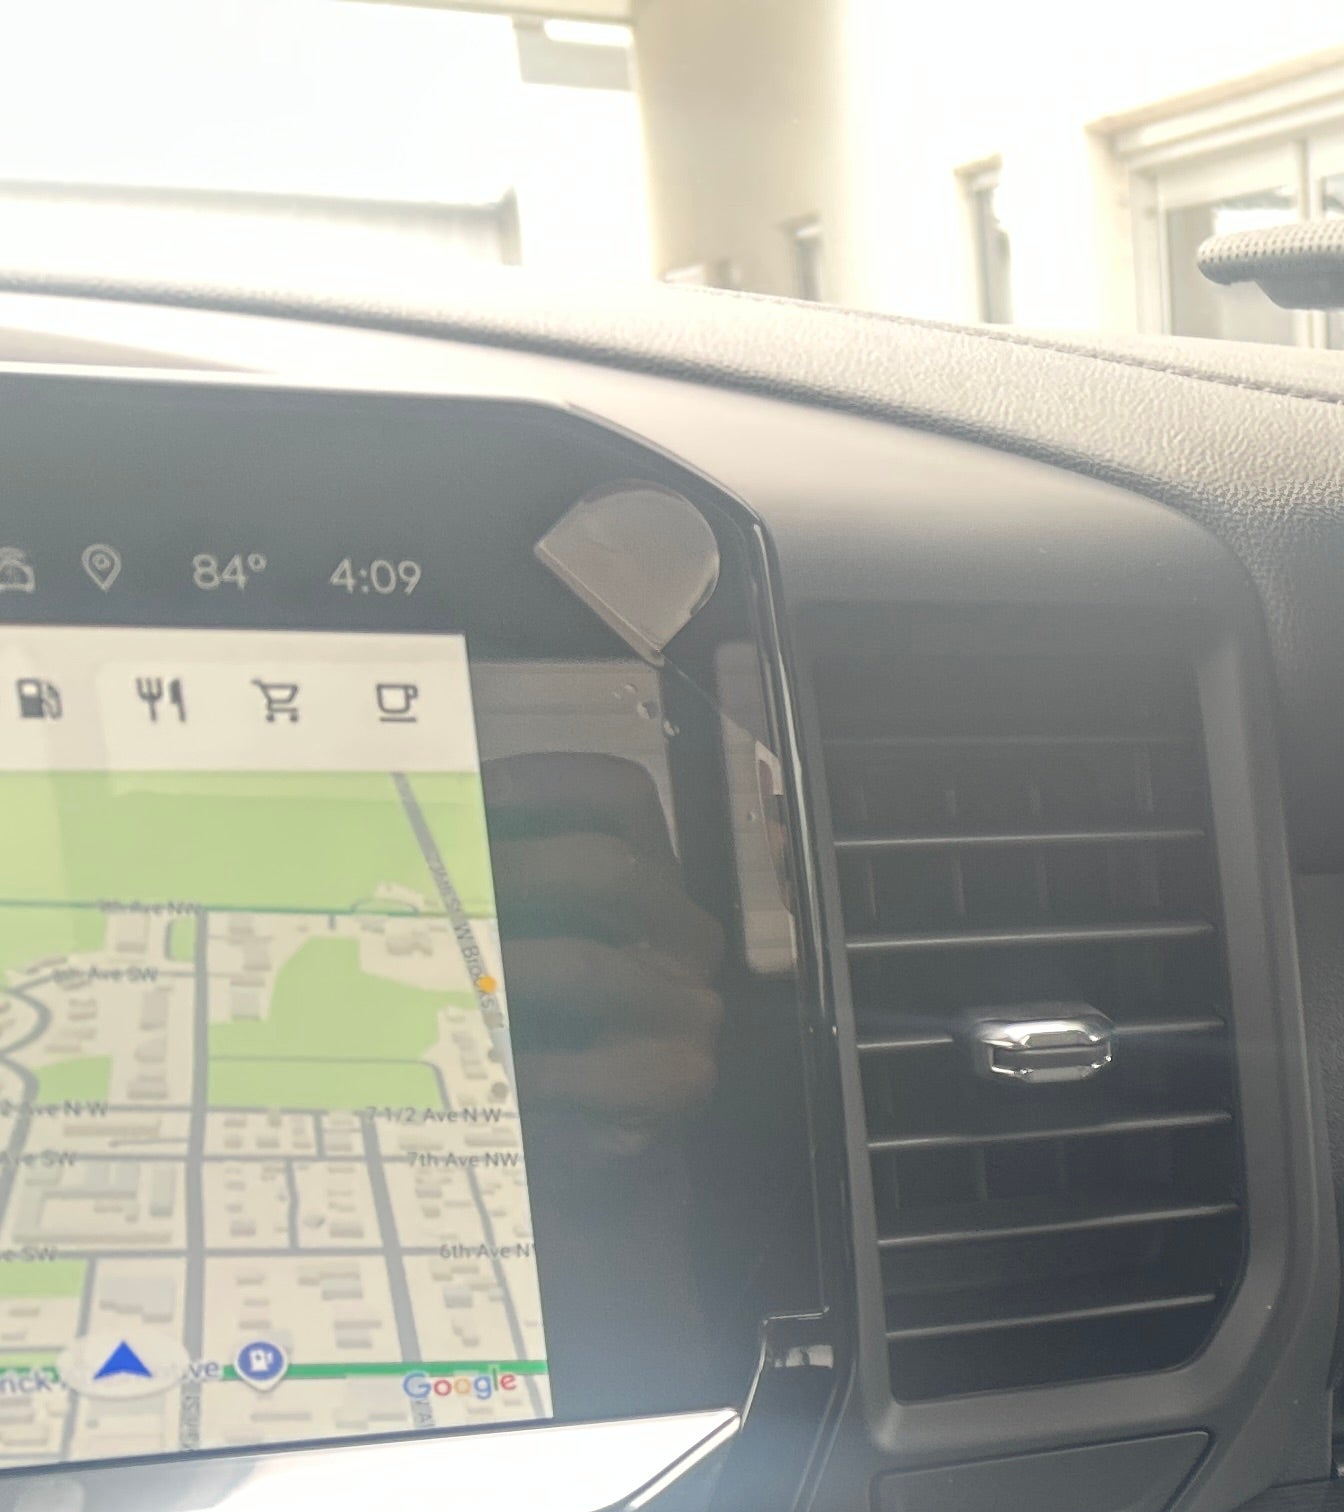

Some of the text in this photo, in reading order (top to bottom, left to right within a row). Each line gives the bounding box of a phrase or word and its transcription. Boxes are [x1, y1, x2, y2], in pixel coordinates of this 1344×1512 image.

[193, 553, 421, 595] 84° 4:09
[423, 1107, 459, 1122] Ave
[464, 1108, 478, 1122] N
[482, 1108, 502, 1122] W
[407, 1151, 518, 1167] 7th Ave NW
[439, 1243, 535, 1258] 6th Ave N
[403, 1368, 517, 1400] Google
